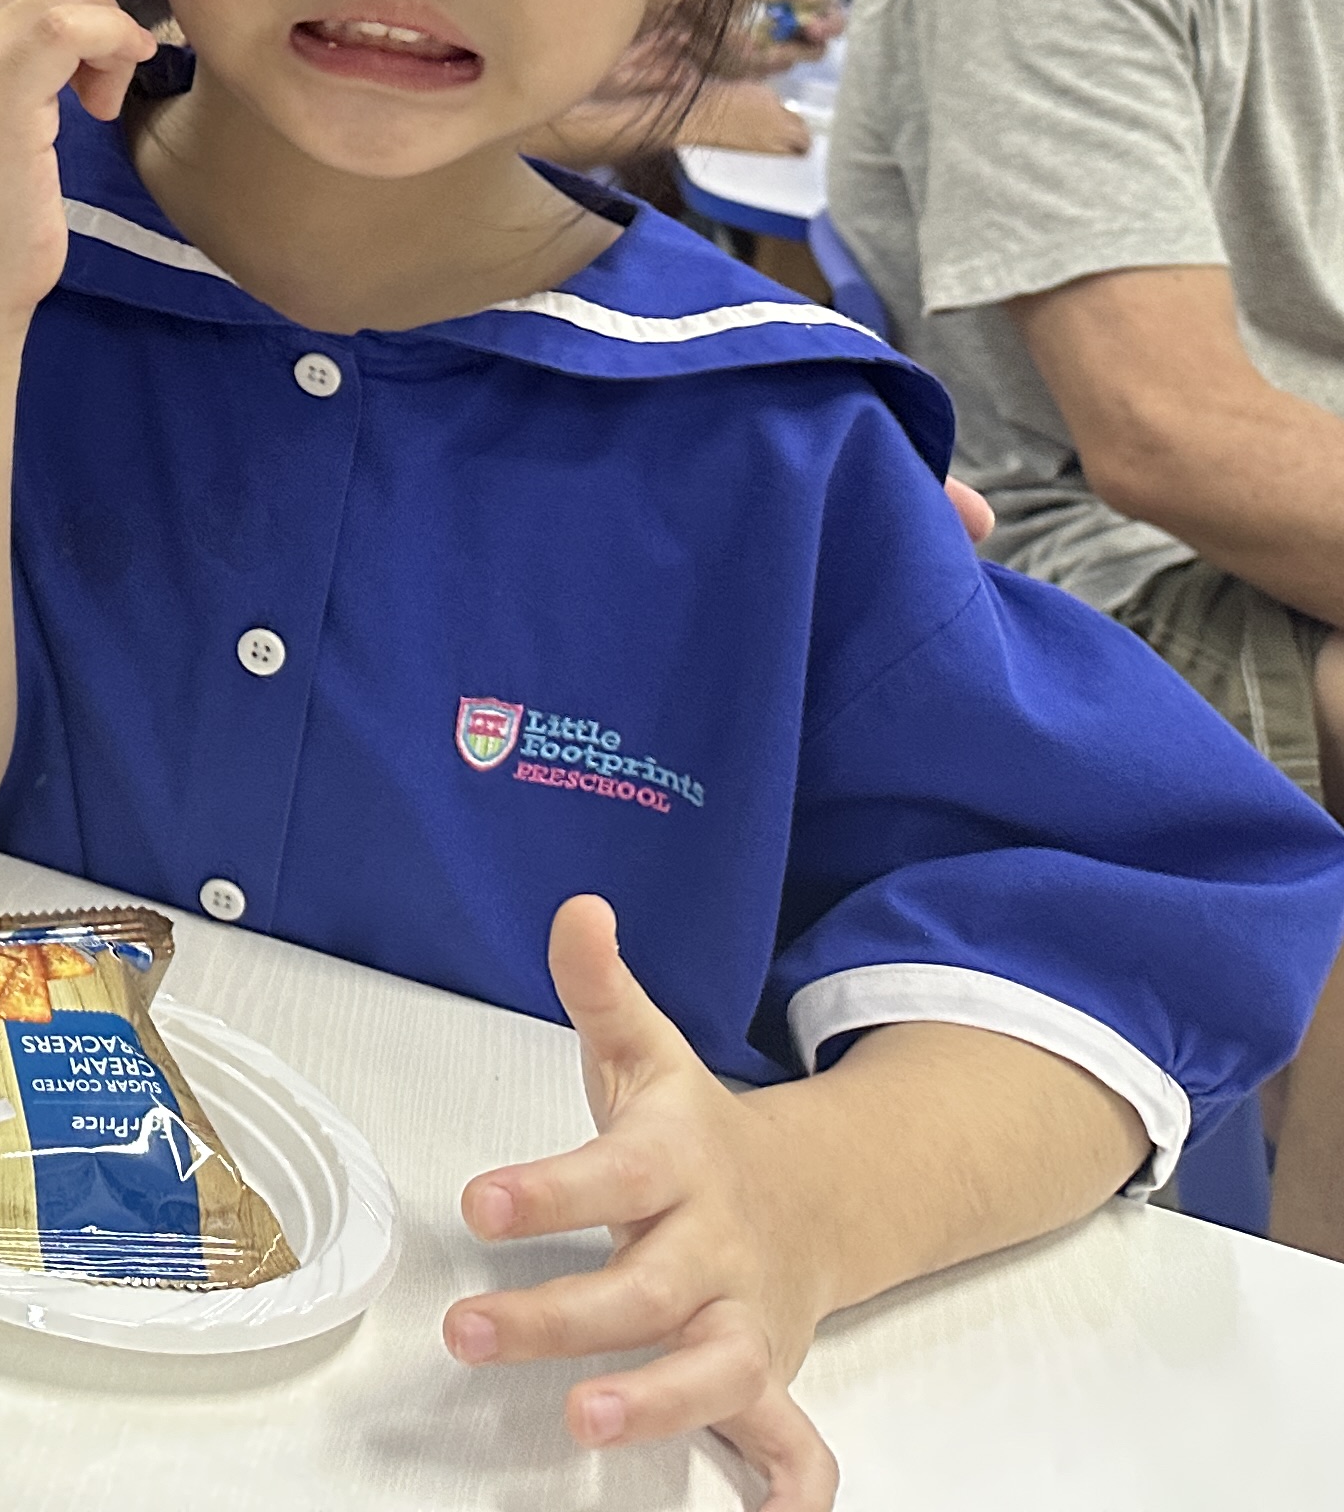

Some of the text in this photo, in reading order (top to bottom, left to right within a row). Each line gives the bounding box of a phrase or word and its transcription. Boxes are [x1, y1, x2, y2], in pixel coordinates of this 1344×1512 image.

[525, 708, 622, 751] Little
[513, 760, 672, 814] PRESCHOOL
[519, 733, 705, 808] Footprints
[69, 1056, 156, 1077] CREAM
[31, 1078, 163, 1095] SUGAR COATED
[71, 1115, 169, 1139] FarPrice
